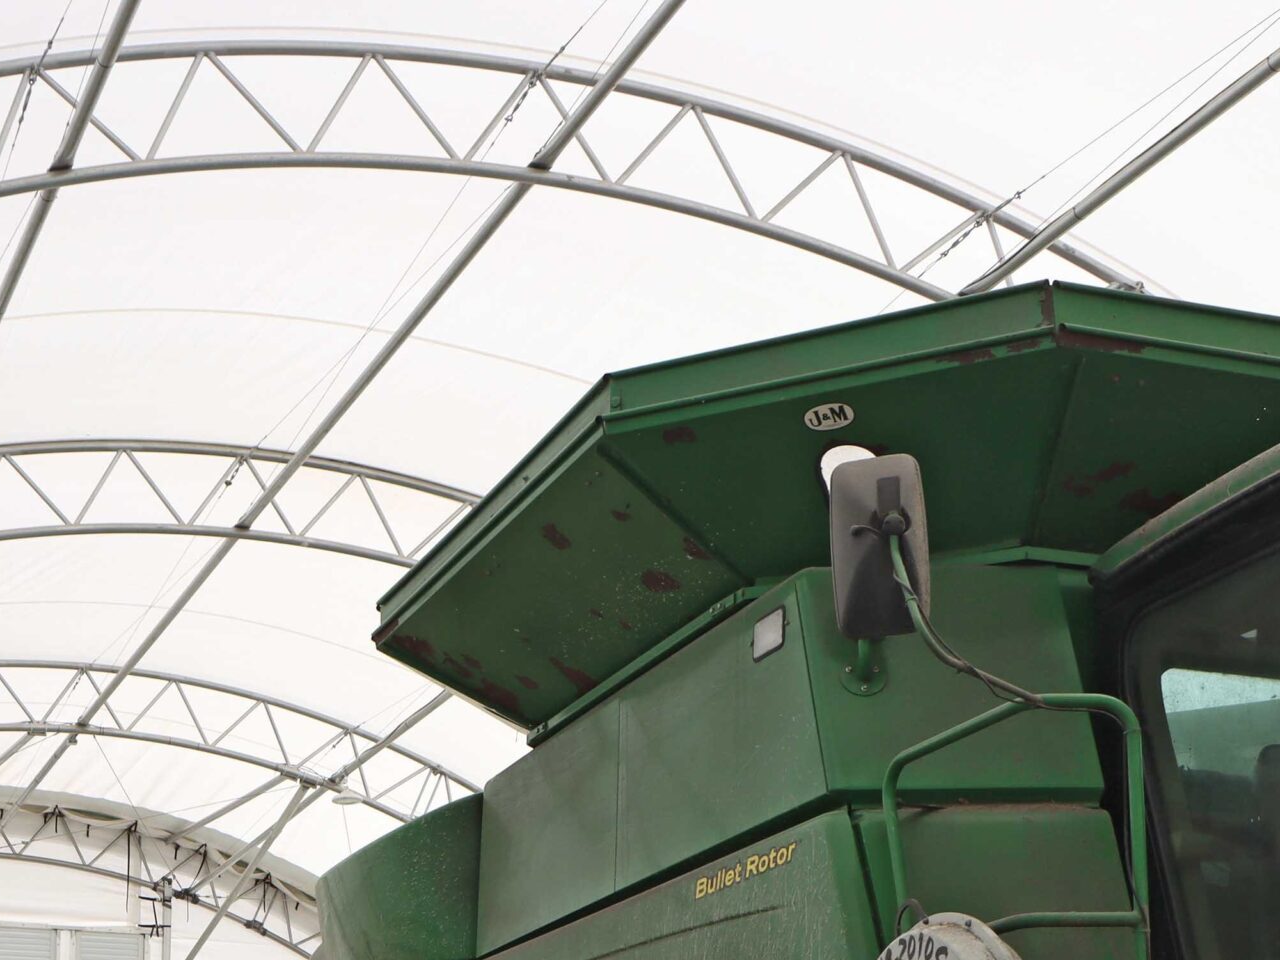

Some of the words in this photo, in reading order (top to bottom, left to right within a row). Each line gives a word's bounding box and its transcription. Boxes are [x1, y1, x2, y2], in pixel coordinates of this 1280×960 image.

[808, 405, 849, 428] J&M
[695, 862, 742, 899] Bullet
[745, 842, 797, 879] Rotor
